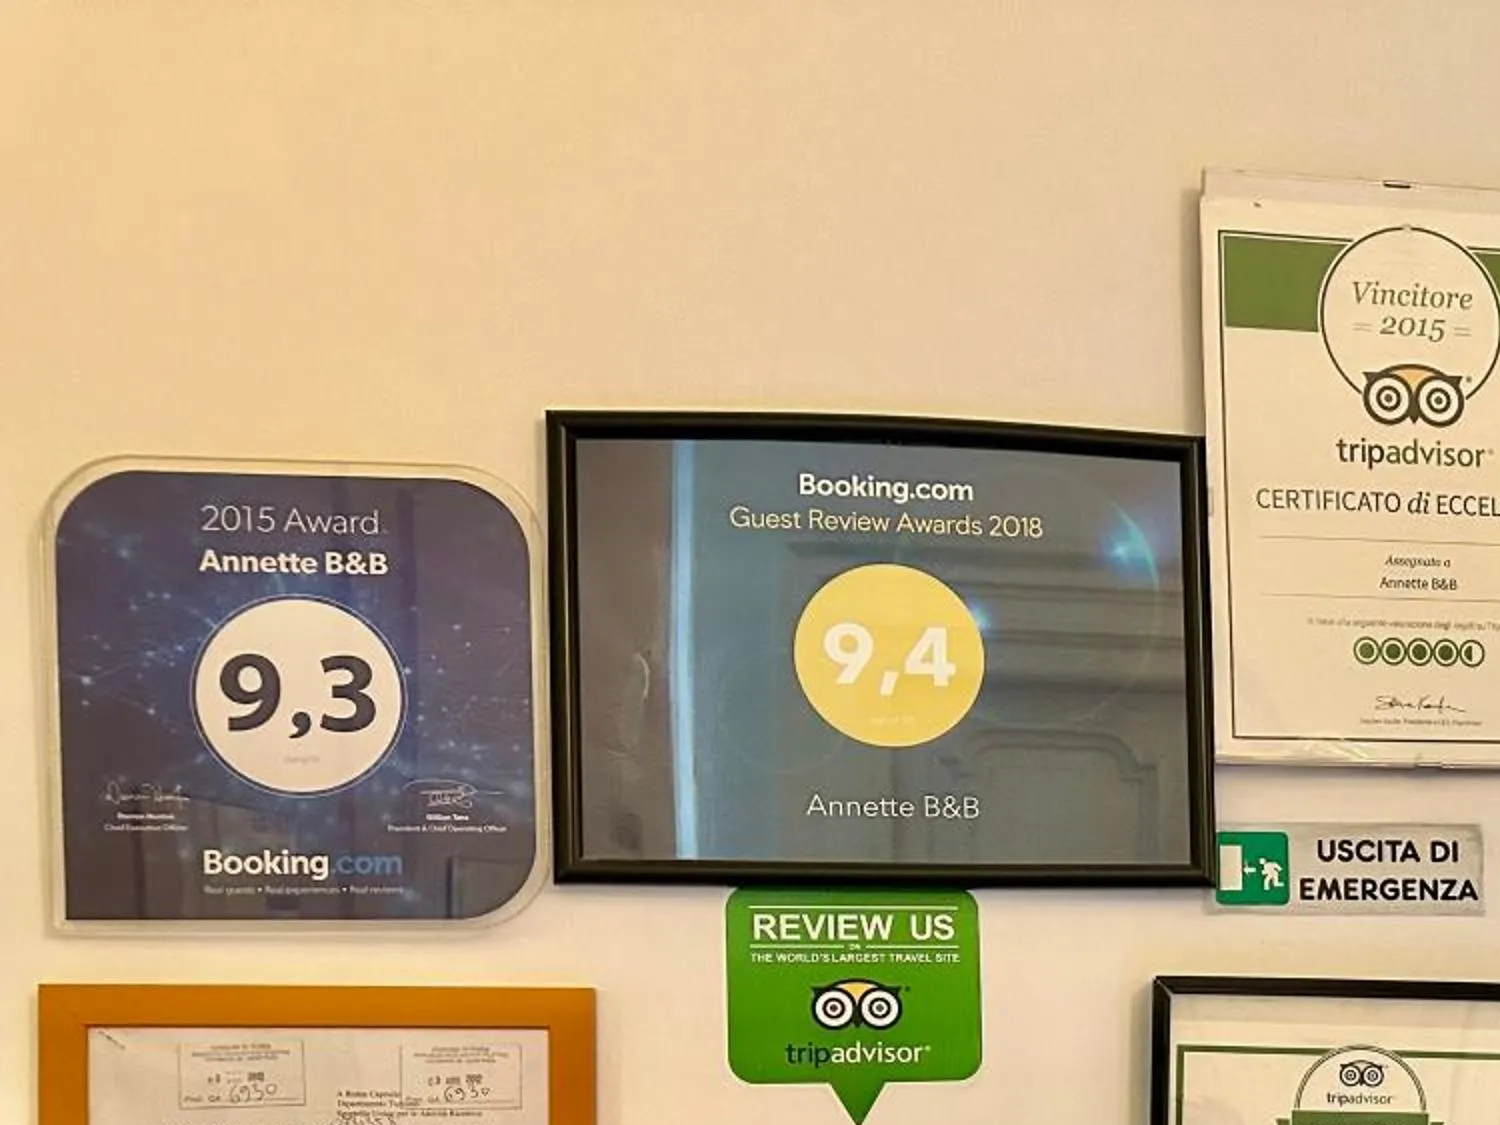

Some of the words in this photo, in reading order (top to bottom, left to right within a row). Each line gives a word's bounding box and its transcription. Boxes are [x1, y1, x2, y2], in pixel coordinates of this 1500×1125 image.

[1352, 281, 1473, 309] Vincitore
[1380, 317, 1445, 342] 2015
[1336, 438, 1486, 469] tripadvisor
[799, 473, 974, 503] Booking.com
[1256, 488, 1401, 513] CERTIFICATO
[1407, 491, 1431, 515] di
[201, 504, 276, 533] 2015
[283, 507, 381, 535] Award
[730, 507, 801, 530] Guest
[809, 509, 889, 533] Review
[896, 512, 983, 536] Awards
[989, 514, 1043, 538] 2018
[199, 549, 318, 575] Annette
[325, 551, 388, 576] B&B
[1379, 576, 1429, 590] Annette
[1431, 578, 1458, 590] B&B
[822, 621, 957, 696] 9,4
[218, 653, 378, 739] 9,3
[807, 794, 915, 819] Annette
[924, 796, 980, 820] B&B
[1317, 839, 1421, 862] USCITA
[1431, 841, 1459, 862] DI
[203, 849, 403, 881] Booking.com
[1299, 877, 1479, 901] EMERGENZA
[753, 914, 893, 941] REVIEW
[910, 914, 955, 940] US
[751, 953, 773, 963] THE
[776, 953, 830, 963] WORLD'S
[832, 953, 885, 963] LARGEST
[889, 953, 932, 963] TRAVEL
[935, 953, 961, 963] SITE
[785, 1041, 923, 1069] tripadvisor
[1326, 1091, 1393, 1108] tripadvisor
